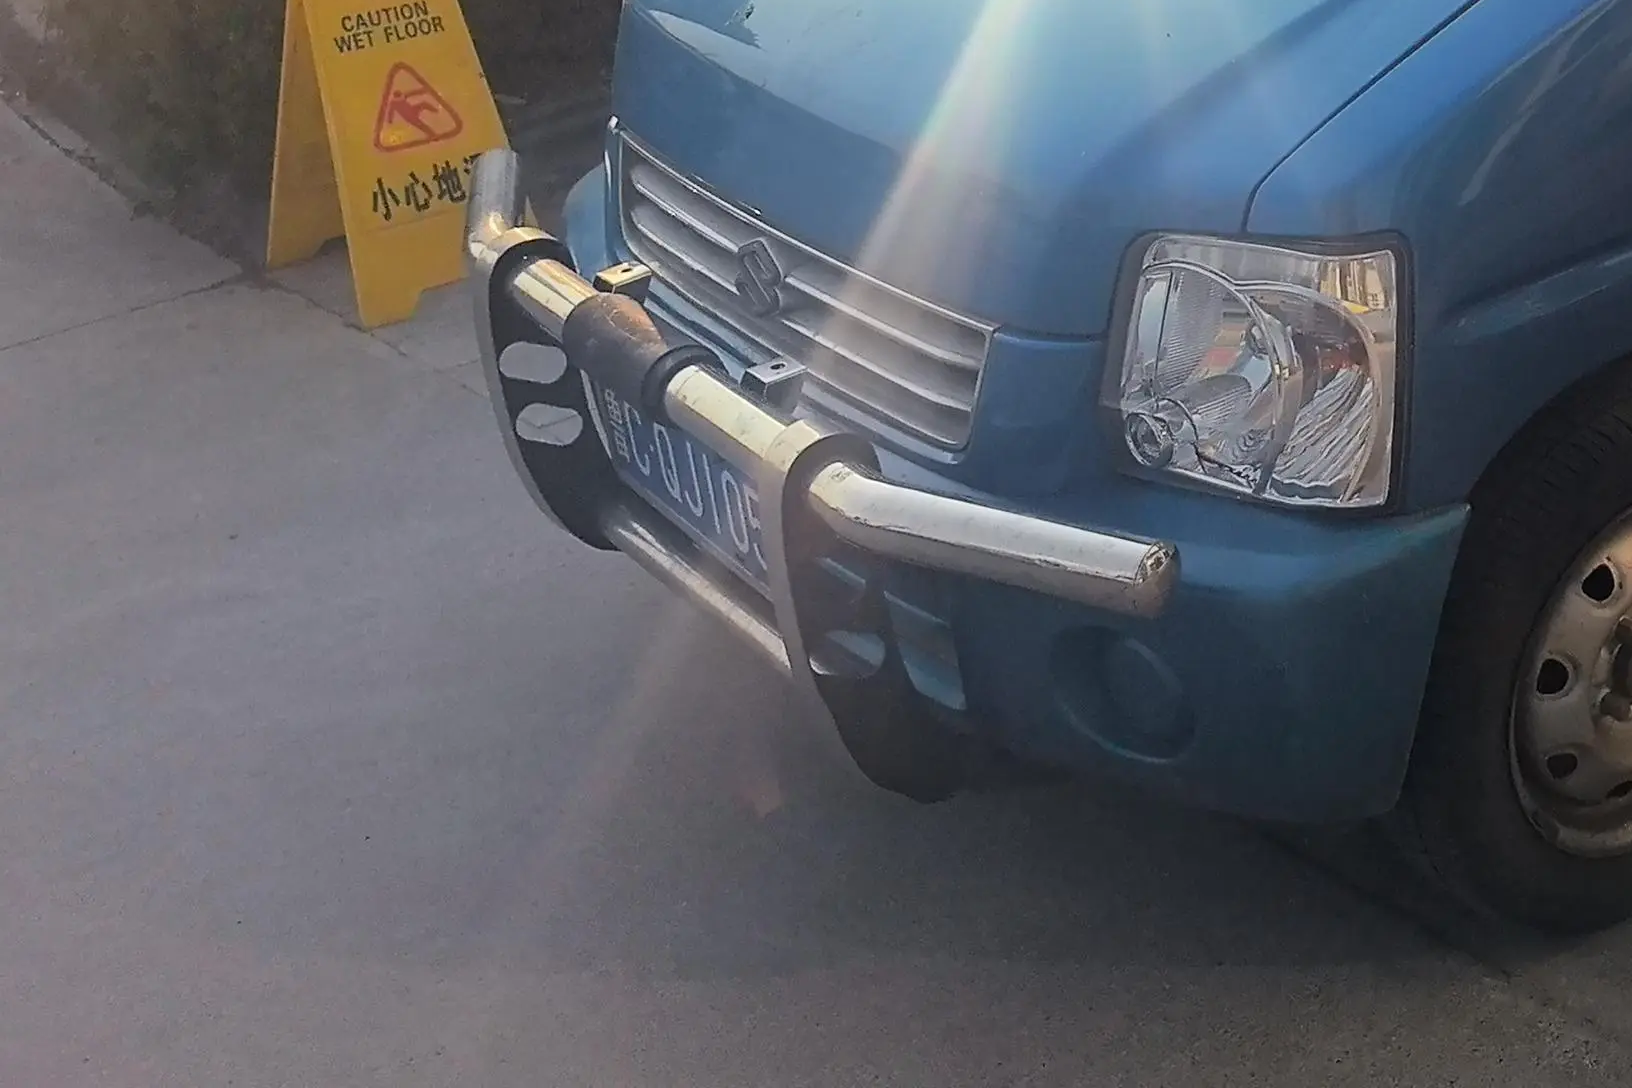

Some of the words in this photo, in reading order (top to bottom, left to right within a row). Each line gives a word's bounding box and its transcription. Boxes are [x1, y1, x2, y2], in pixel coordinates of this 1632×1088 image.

[333, 27, 375, 54] WET
[383, 15, 446, 44] FLOOR
[340, 0, 429, 34] CAUTION
[371, 152, 484, 221] 小心地
